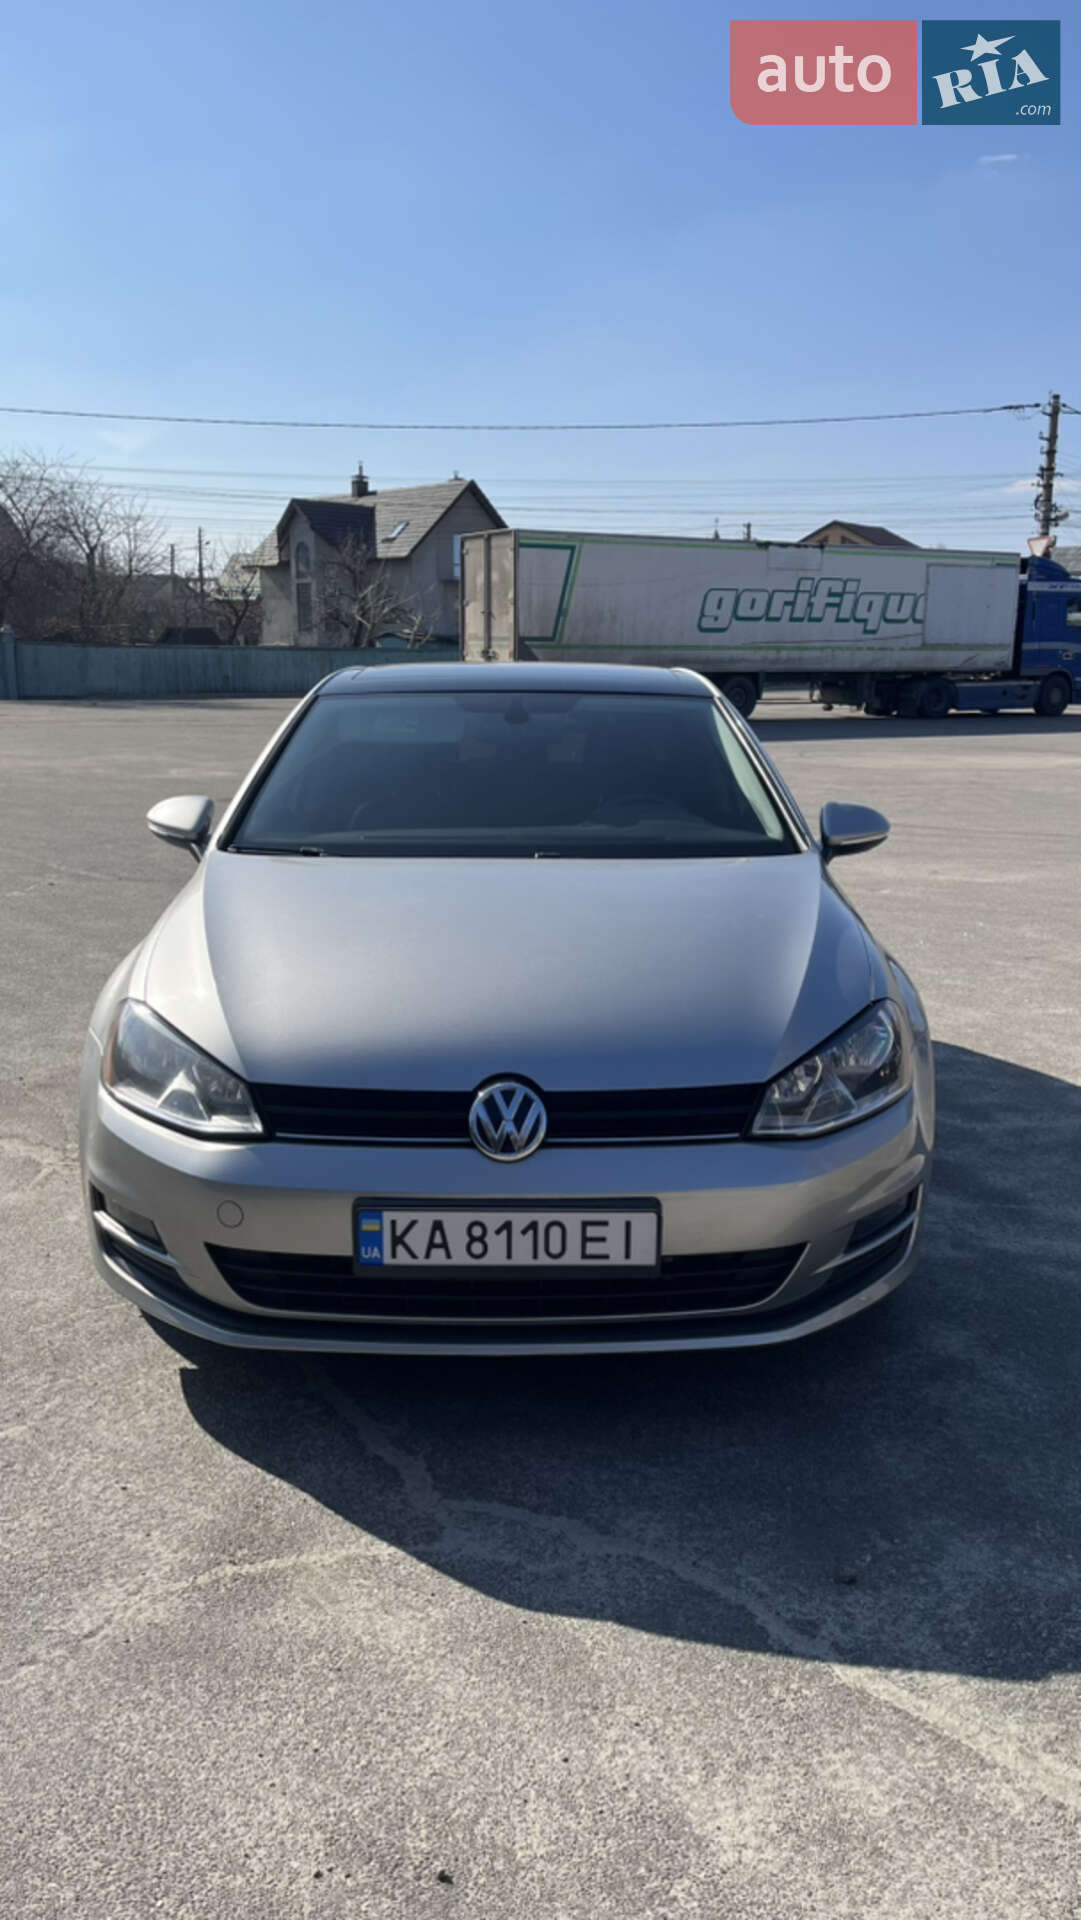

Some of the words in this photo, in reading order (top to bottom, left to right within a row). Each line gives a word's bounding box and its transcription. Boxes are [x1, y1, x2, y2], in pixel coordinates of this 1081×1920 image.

[361, 1246, 381, 1259] UA
[389, 1218, 453, 1260] KA
[465, 1219, 568, 1260] 8110
